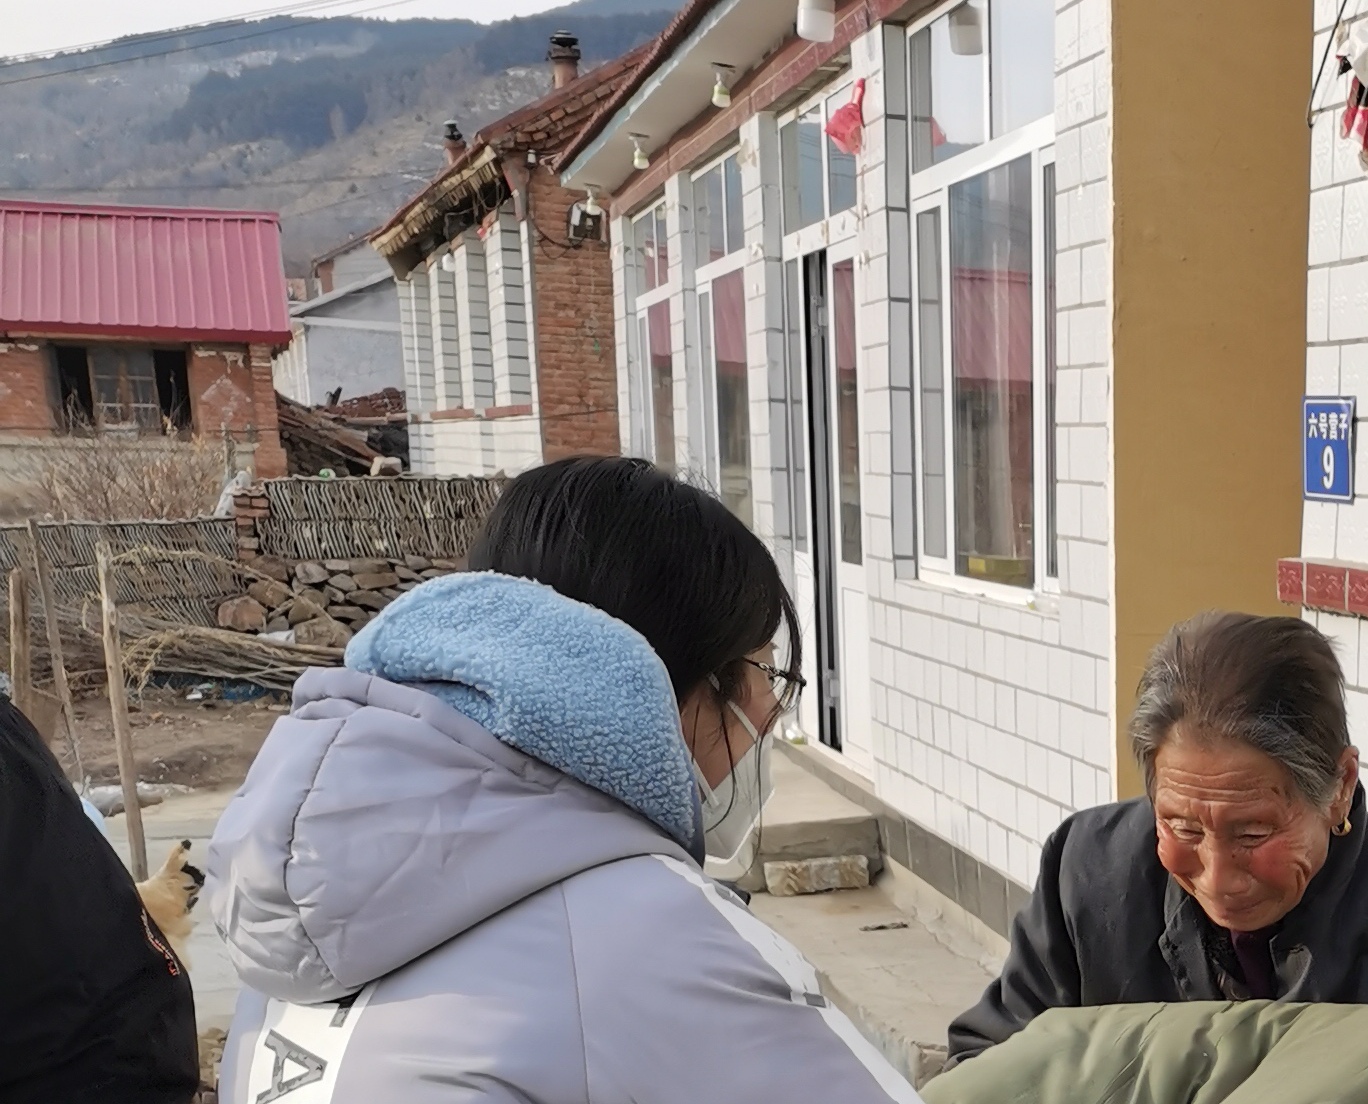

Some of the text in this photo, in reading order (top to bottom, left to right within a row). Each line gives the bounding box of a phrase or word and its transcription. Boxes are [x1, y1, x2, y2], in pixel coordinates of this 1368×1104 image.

[1308, 412, 1348, 440] 六号营子
[1323, 445, 1335, 489] 9
